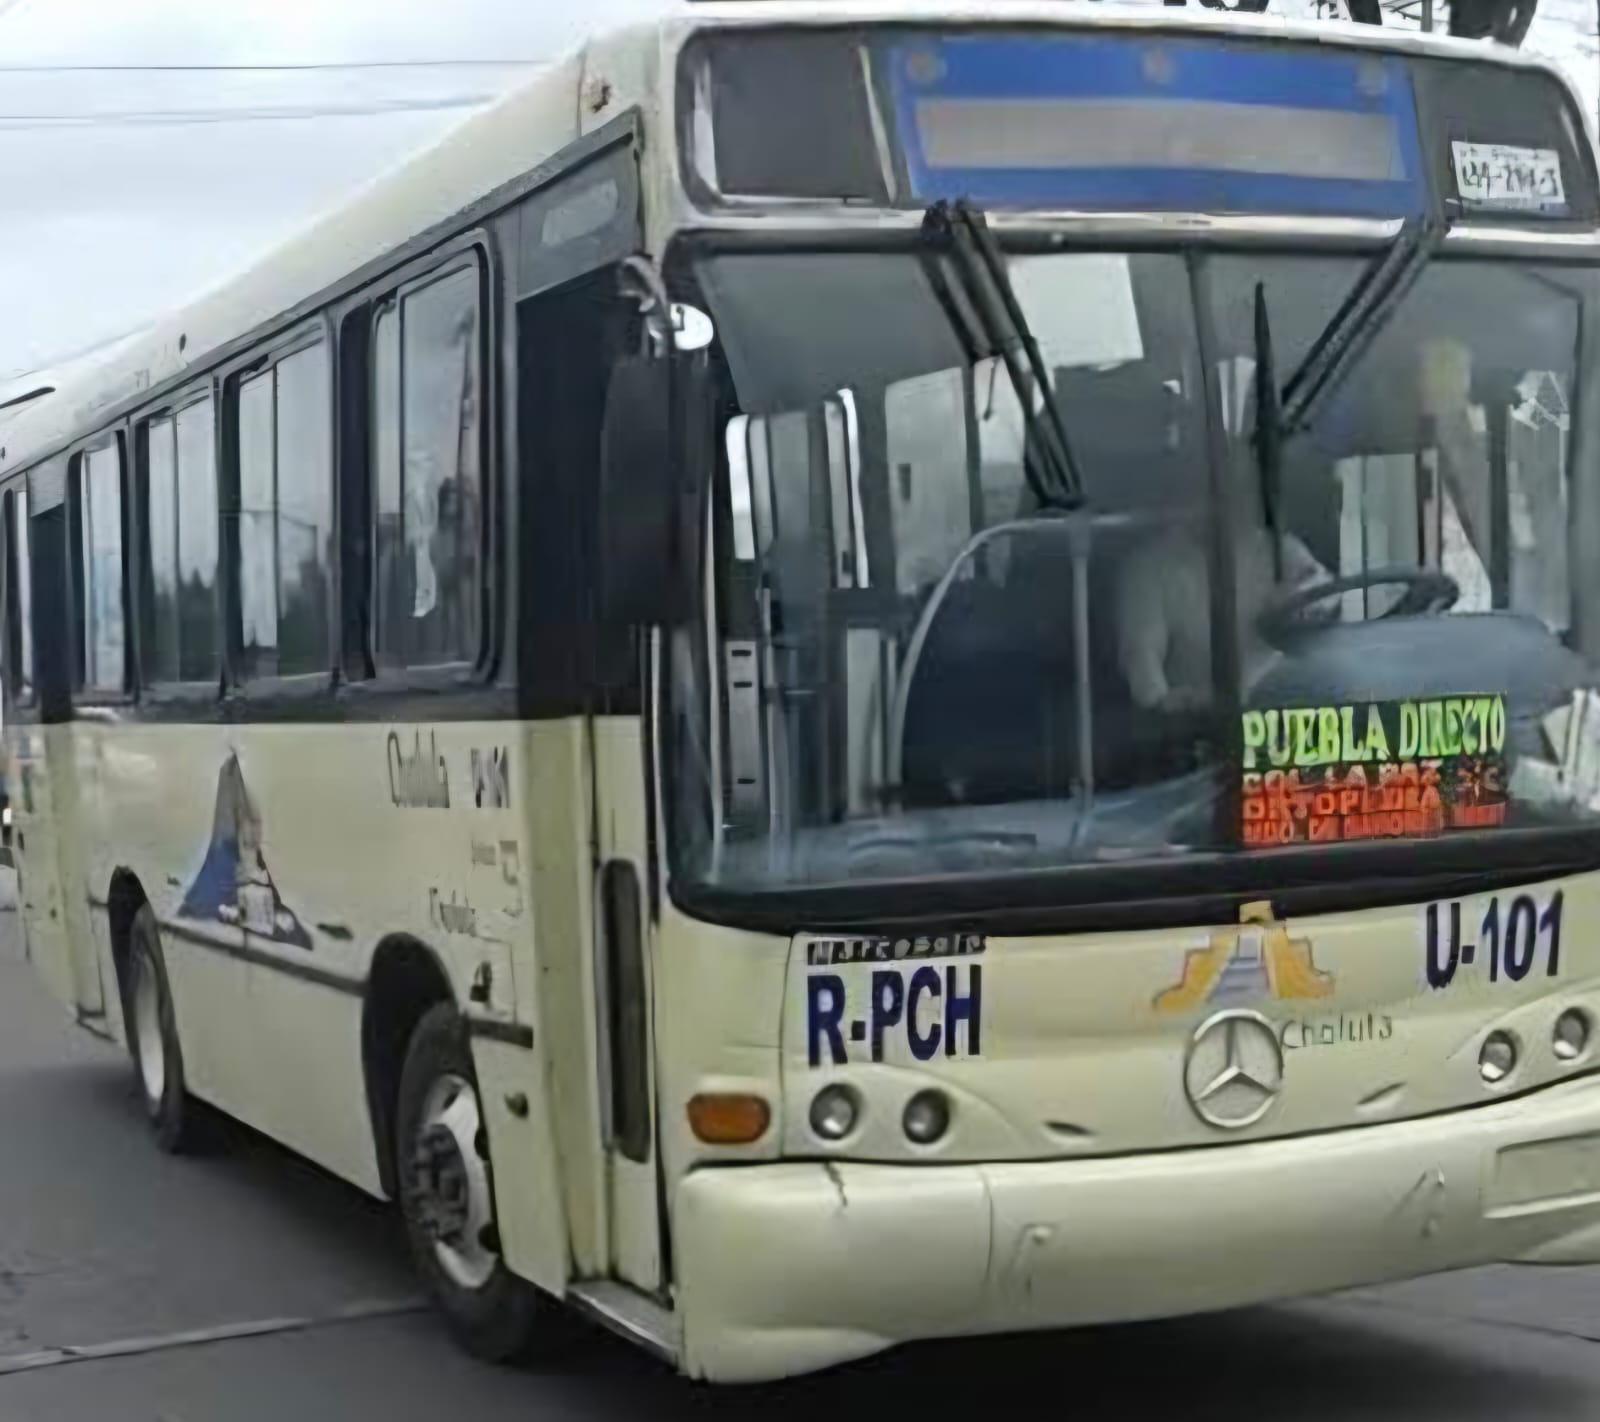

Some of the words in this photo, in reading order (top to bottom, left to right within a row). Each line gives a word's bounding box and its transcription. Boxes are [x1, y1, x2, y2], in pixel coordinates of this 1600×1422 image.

[1242, 704, 1390, 768] PUEBLA
[1399, 696, 1505, 760] DIRECTO
[1426, 887, 1564, 990] U-101
[808, 964, 982, 1066] R-PCH
